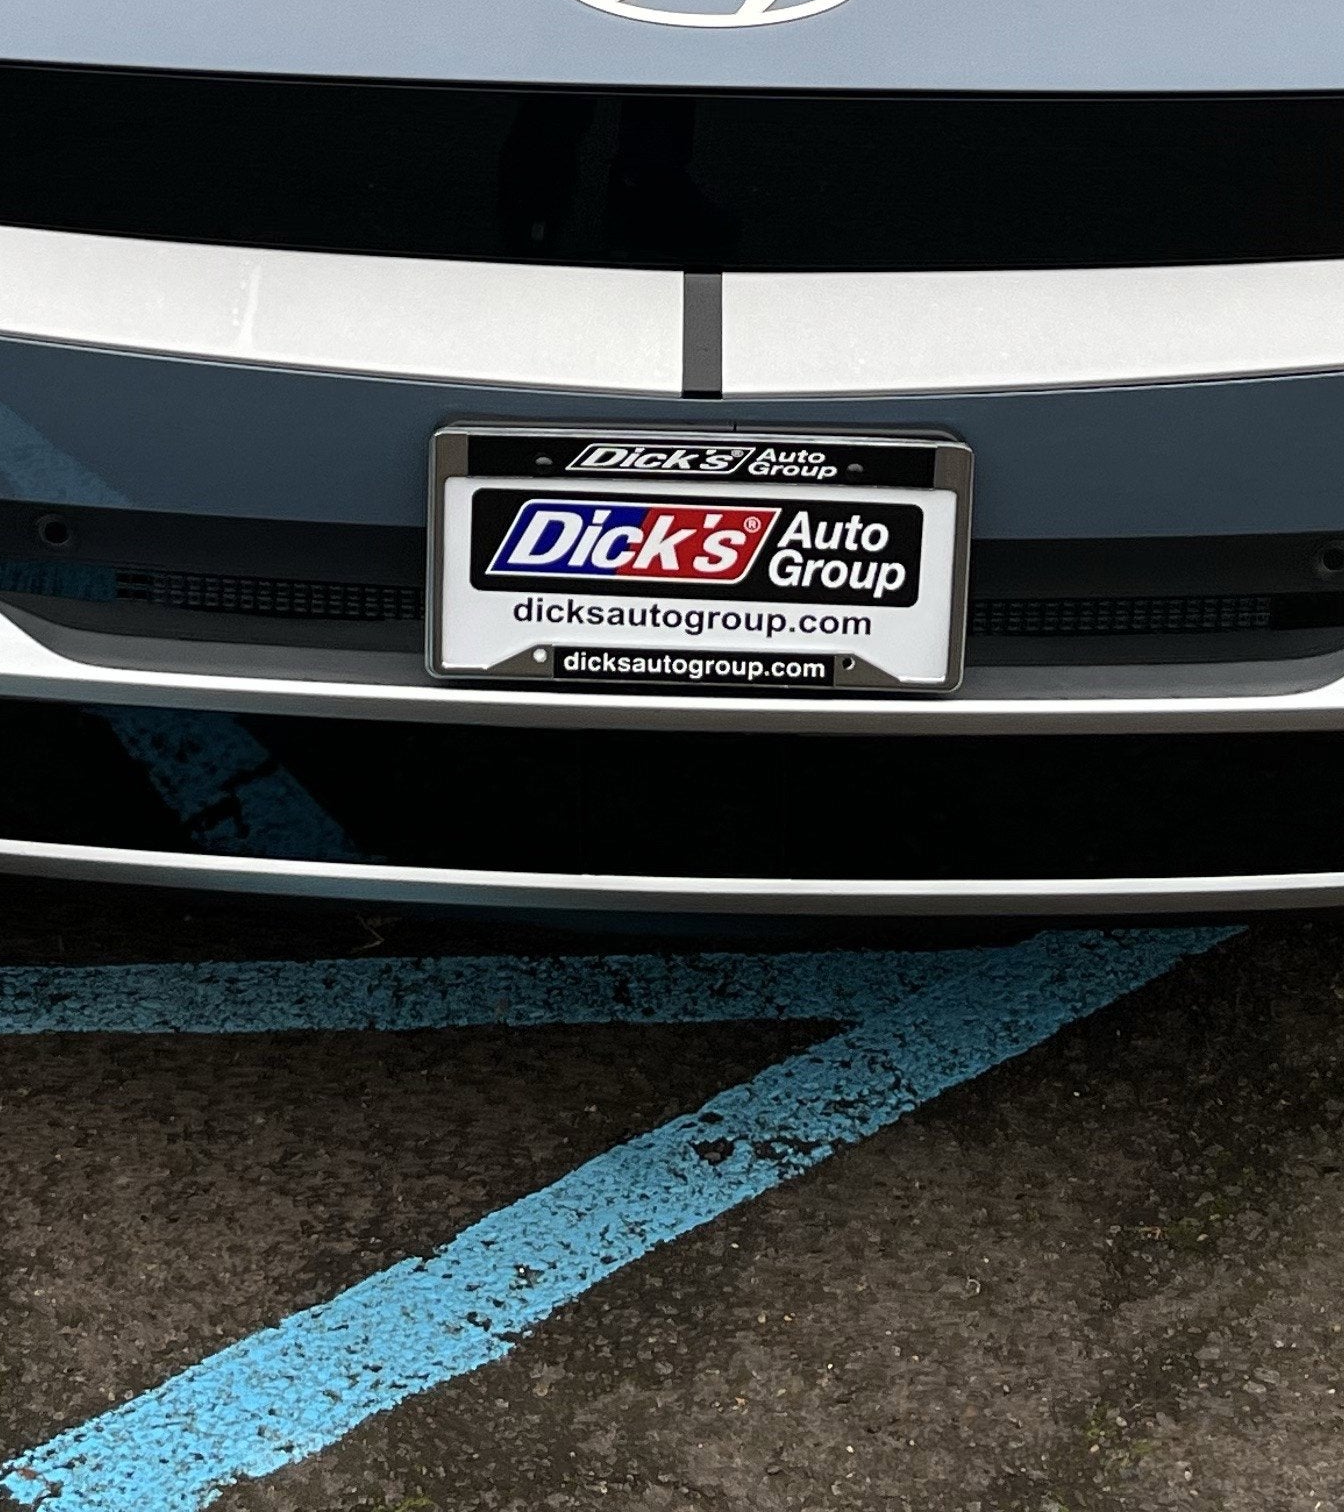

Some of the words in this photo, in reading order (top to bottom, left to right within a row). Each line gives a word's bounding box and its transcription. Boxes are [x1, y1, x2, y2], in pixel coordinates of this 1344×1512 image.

[581, 446, 734, 470] Dick's
[748, 462, 838, 480] Group
[756, 448, 826, 464] Auto
[506, 509, 746, 574] Dick's
[777, 510, 890, 552] Auto
[768, 548, 906, 598] Group
[512, 597, 873, 638] dicksautogroup.com
[562, 651, 826, 681] dicksautogroup.com
